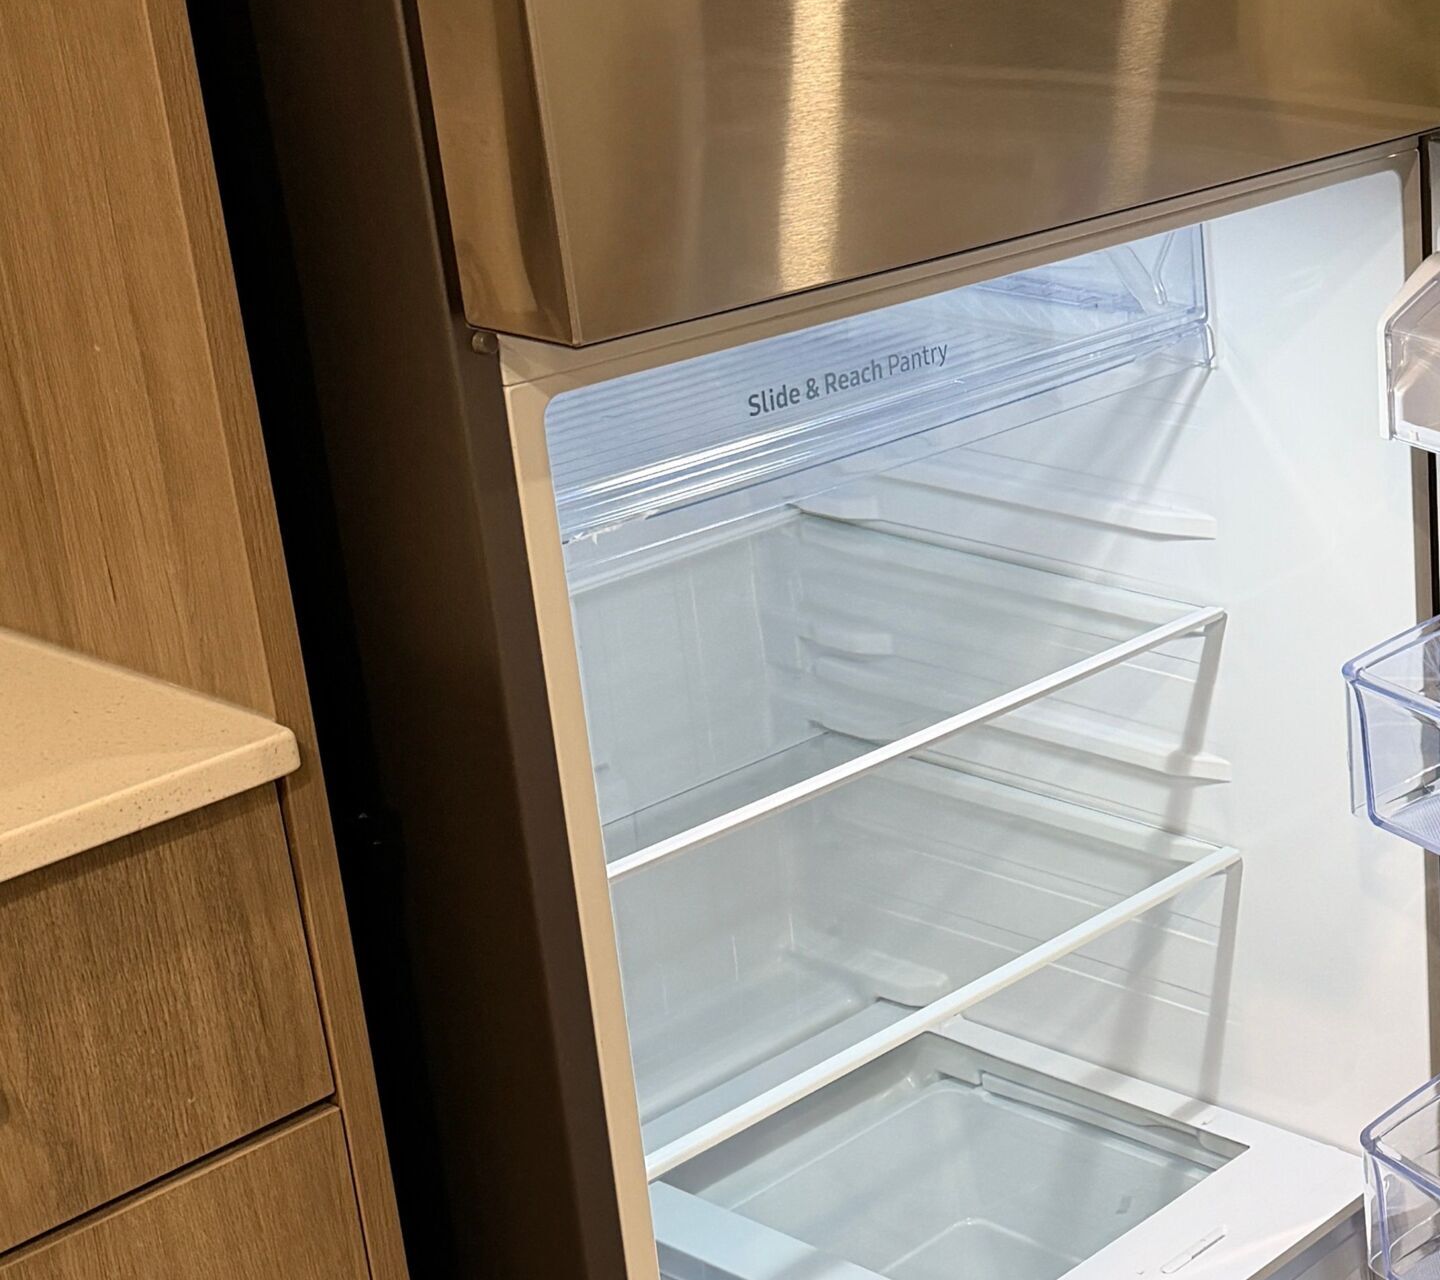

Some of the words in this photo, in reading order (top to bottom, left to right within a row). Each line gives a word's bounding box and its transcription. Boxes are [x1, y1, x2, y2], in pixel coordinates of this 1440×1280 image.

[748, 384, 801, 417] Slide
[806, 378, 820, 401] &
[824, 360, 883, 395] Reach
[888, 344, 948, 376] Pantry
